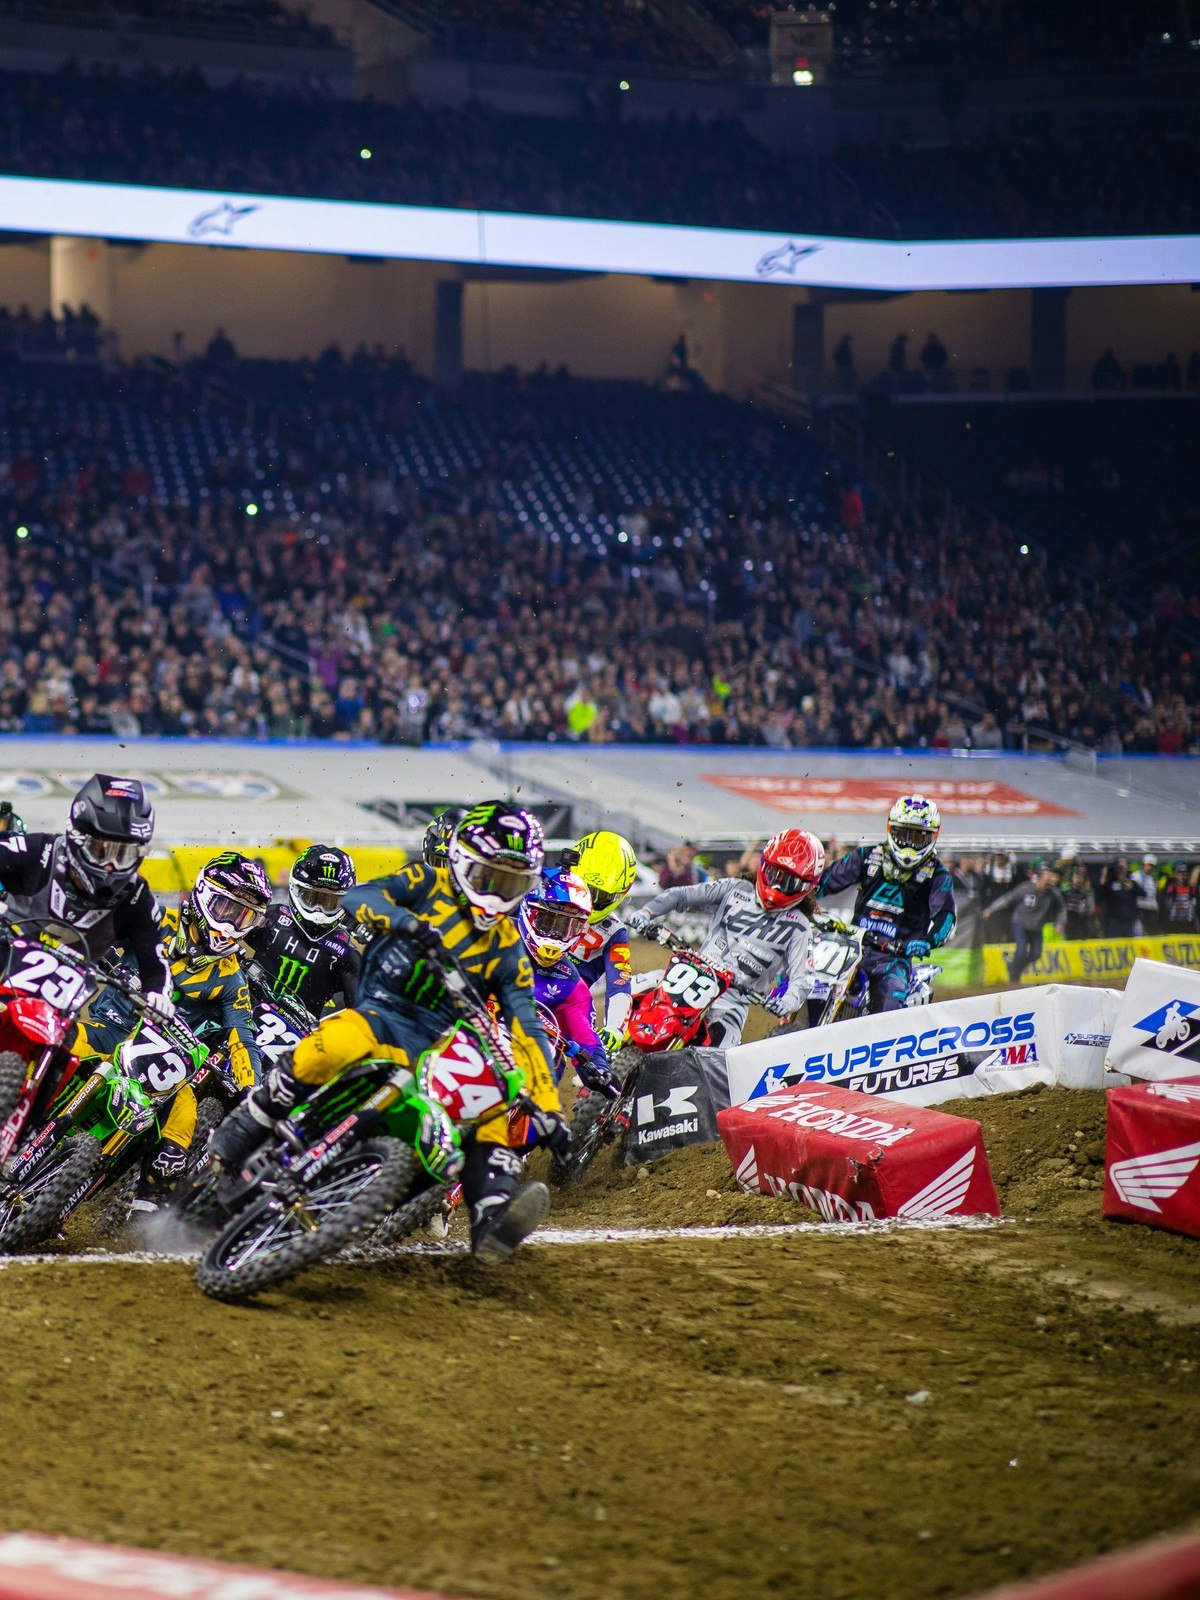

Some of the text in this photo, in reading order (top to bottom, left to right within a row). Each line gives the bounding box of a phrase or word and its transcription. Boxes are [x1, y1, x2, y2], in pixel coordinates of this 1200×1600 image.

[867, 920, 897, 938] YAMAHA
[3, 950, 84, 1010] 23
[815, 940, 851, 977] 91
[661, 962, 720, 1010] 93
[121, 1026, 187, 1091] 73
[255, 1012, 301, 1063] 32
[804, 1012, 1036, 1081] SUPERCROSS
[987, 1043, 1039, 1067] AMA
[432, 1043, 503, 1119] 24
[849, 1056, 960, 1094] FUTURES
[638, 1118, 699, 1145] Kawasaki
[768, 1101, 916, 1146] HONDA
